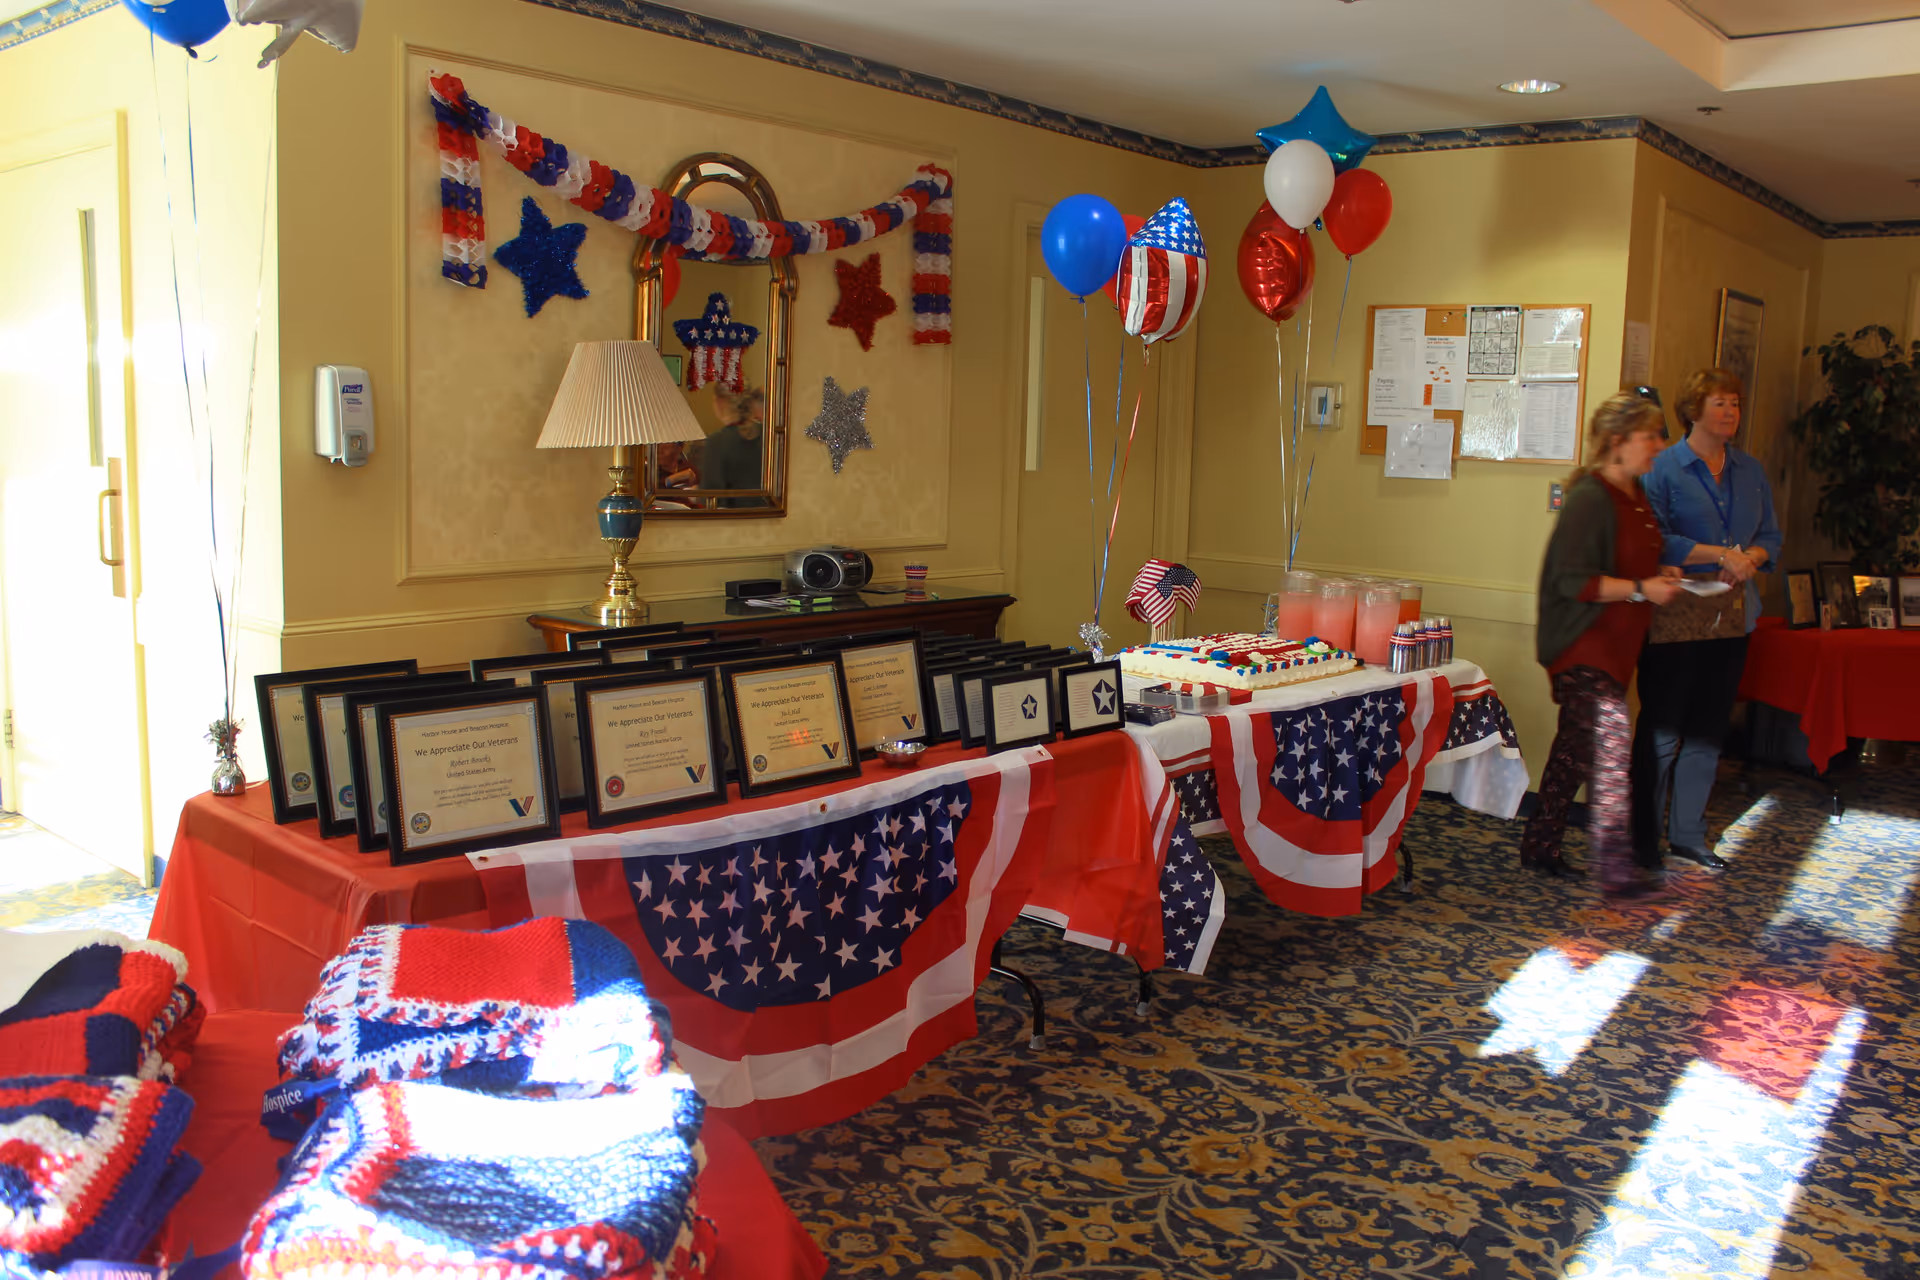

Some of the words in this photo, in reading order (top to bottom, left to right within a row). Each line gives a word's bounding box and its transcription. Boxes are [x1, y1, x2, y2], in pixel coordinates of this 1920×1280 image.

[751, 701, 760, 709] We
[761, 697, 790, 708] Appreciate
[790, 695, 800, 703] Our
[801, 693, 825, 701] Veterans
[607, 720, 618, 728] We
[619, 715, 653, 727] Appreciate
[666, 710, 693, 720] Veterans
[421, 730, 440, 738] Harbor
[441, 728, 457, 736] House
[470, 723, 488, 732] Beacon
[415, 748, 428, 757] We
[430, 743, 470, 756] Appreciate
[472, 741, 485, 750] Our
[487, 737, 518, 747] Veterans
[446, 771, 464, 779] United
[465, 768, 481, 776] States
[263, 1088, 304, 1114] Hospice
